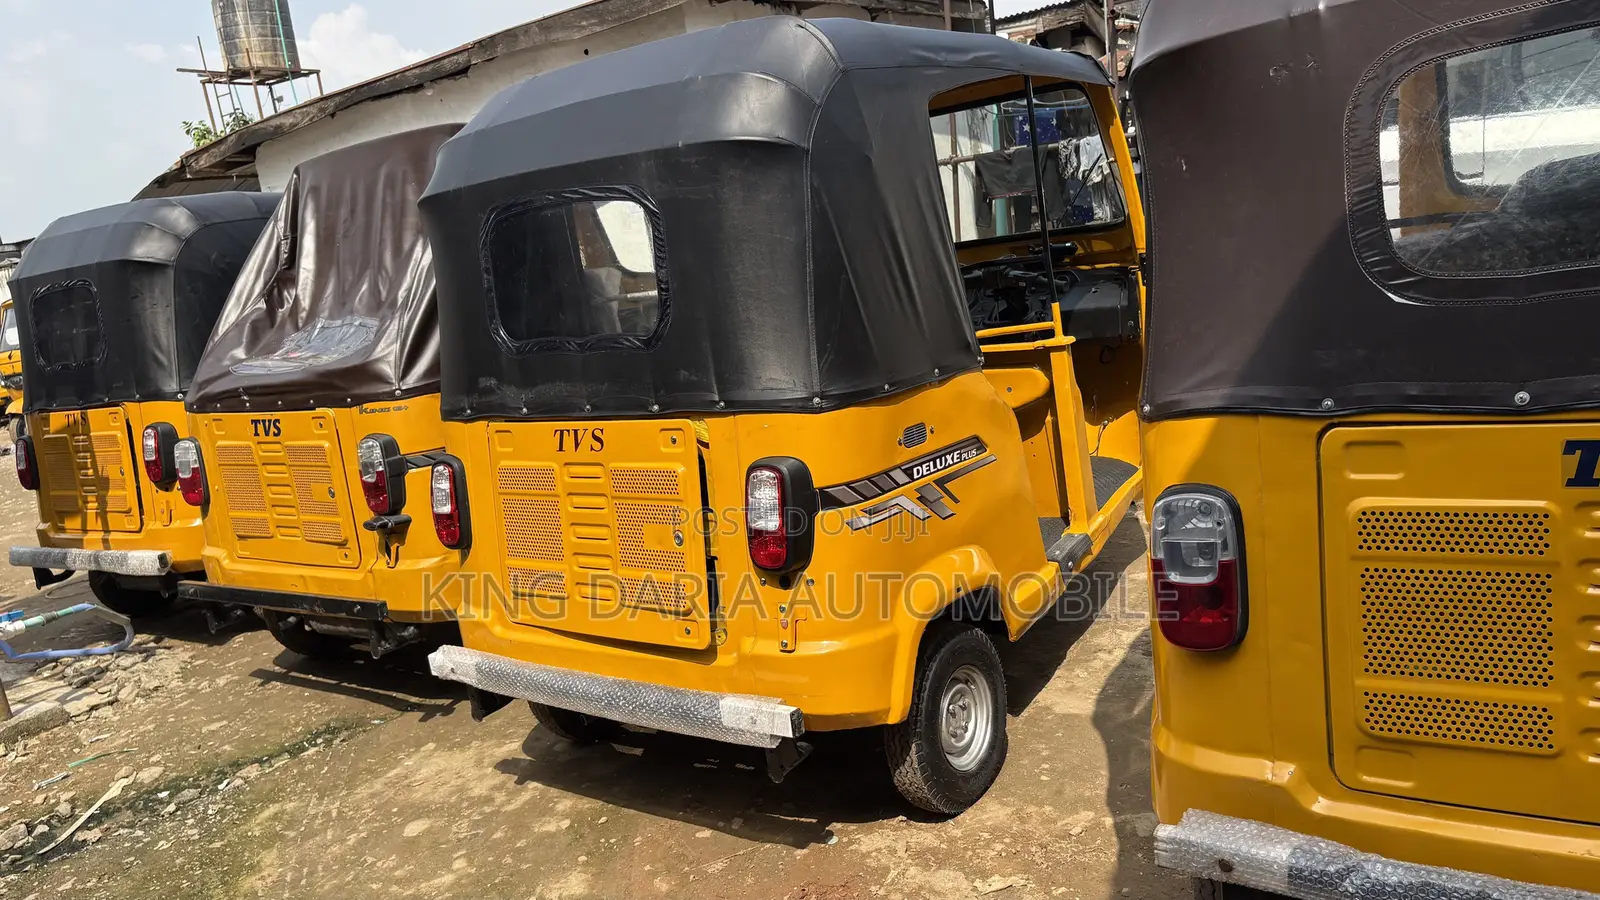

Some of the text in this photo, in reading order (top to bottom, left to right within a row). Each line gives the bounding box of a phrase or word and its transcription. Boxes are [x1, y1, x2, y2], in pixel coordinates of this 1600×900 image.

[64, 411, 87, 427] TVS
[250, 418, 281, 437] TVS
[553, 427, 604, 453] TVS
[912, 448, 977, 479] DELUXE PLUS
